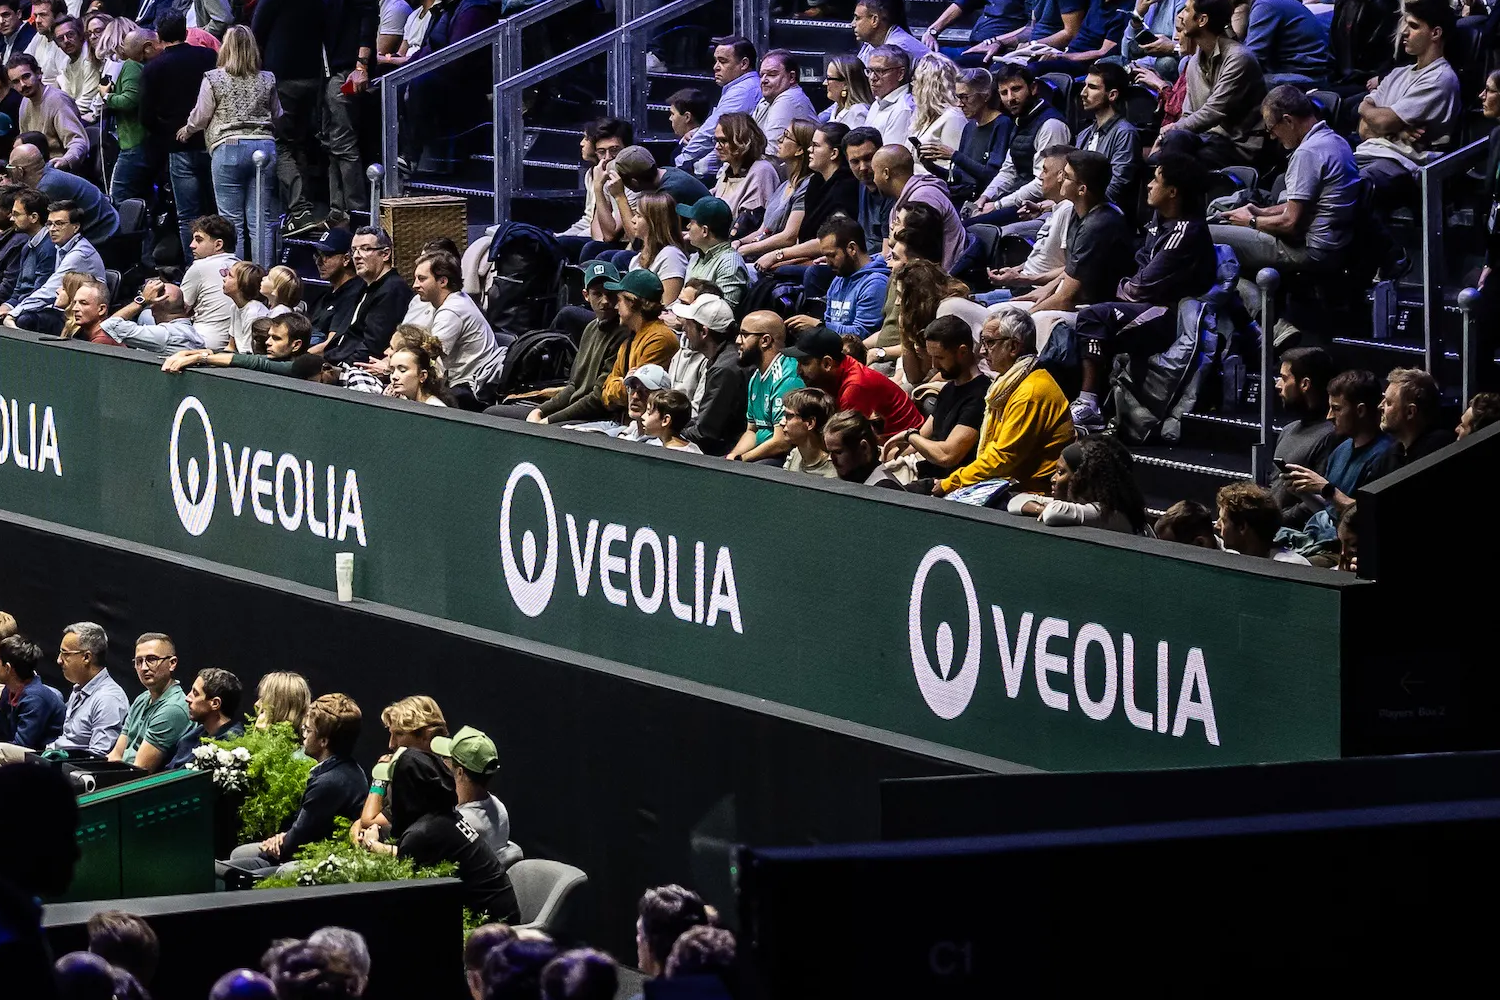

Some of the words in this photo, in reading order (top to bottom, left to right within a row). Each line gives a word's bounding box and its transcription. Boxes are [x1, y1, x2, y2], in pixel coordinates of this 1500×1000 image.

[223, 441, 367, 547] VEOLIA
[565, 512, 744, 635] VEOLIA
[991, 604, 1220, 747] VEOLIA
[928, 939, 973, 976] C1
